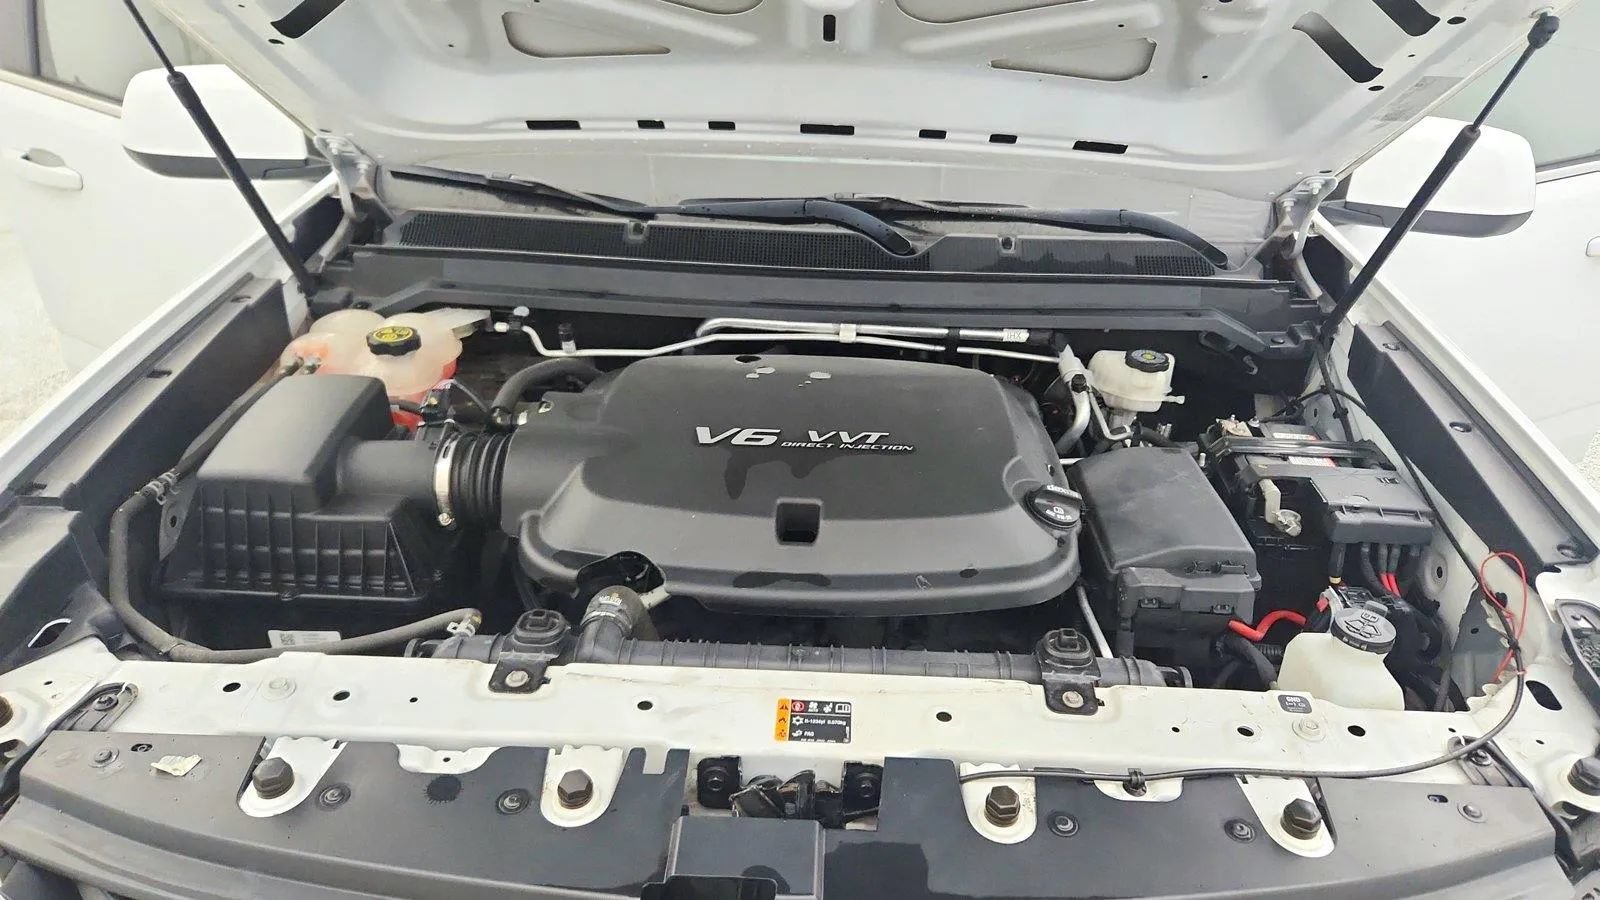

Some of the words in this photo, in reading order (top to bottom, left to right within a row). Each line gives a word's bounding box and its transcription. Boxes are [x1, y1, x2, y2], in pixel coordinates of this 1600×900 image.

[695, 426, 781, 446] V6
[808, 430, 890, 444] VVT
[839, 443, 914, 451] INJECTION
